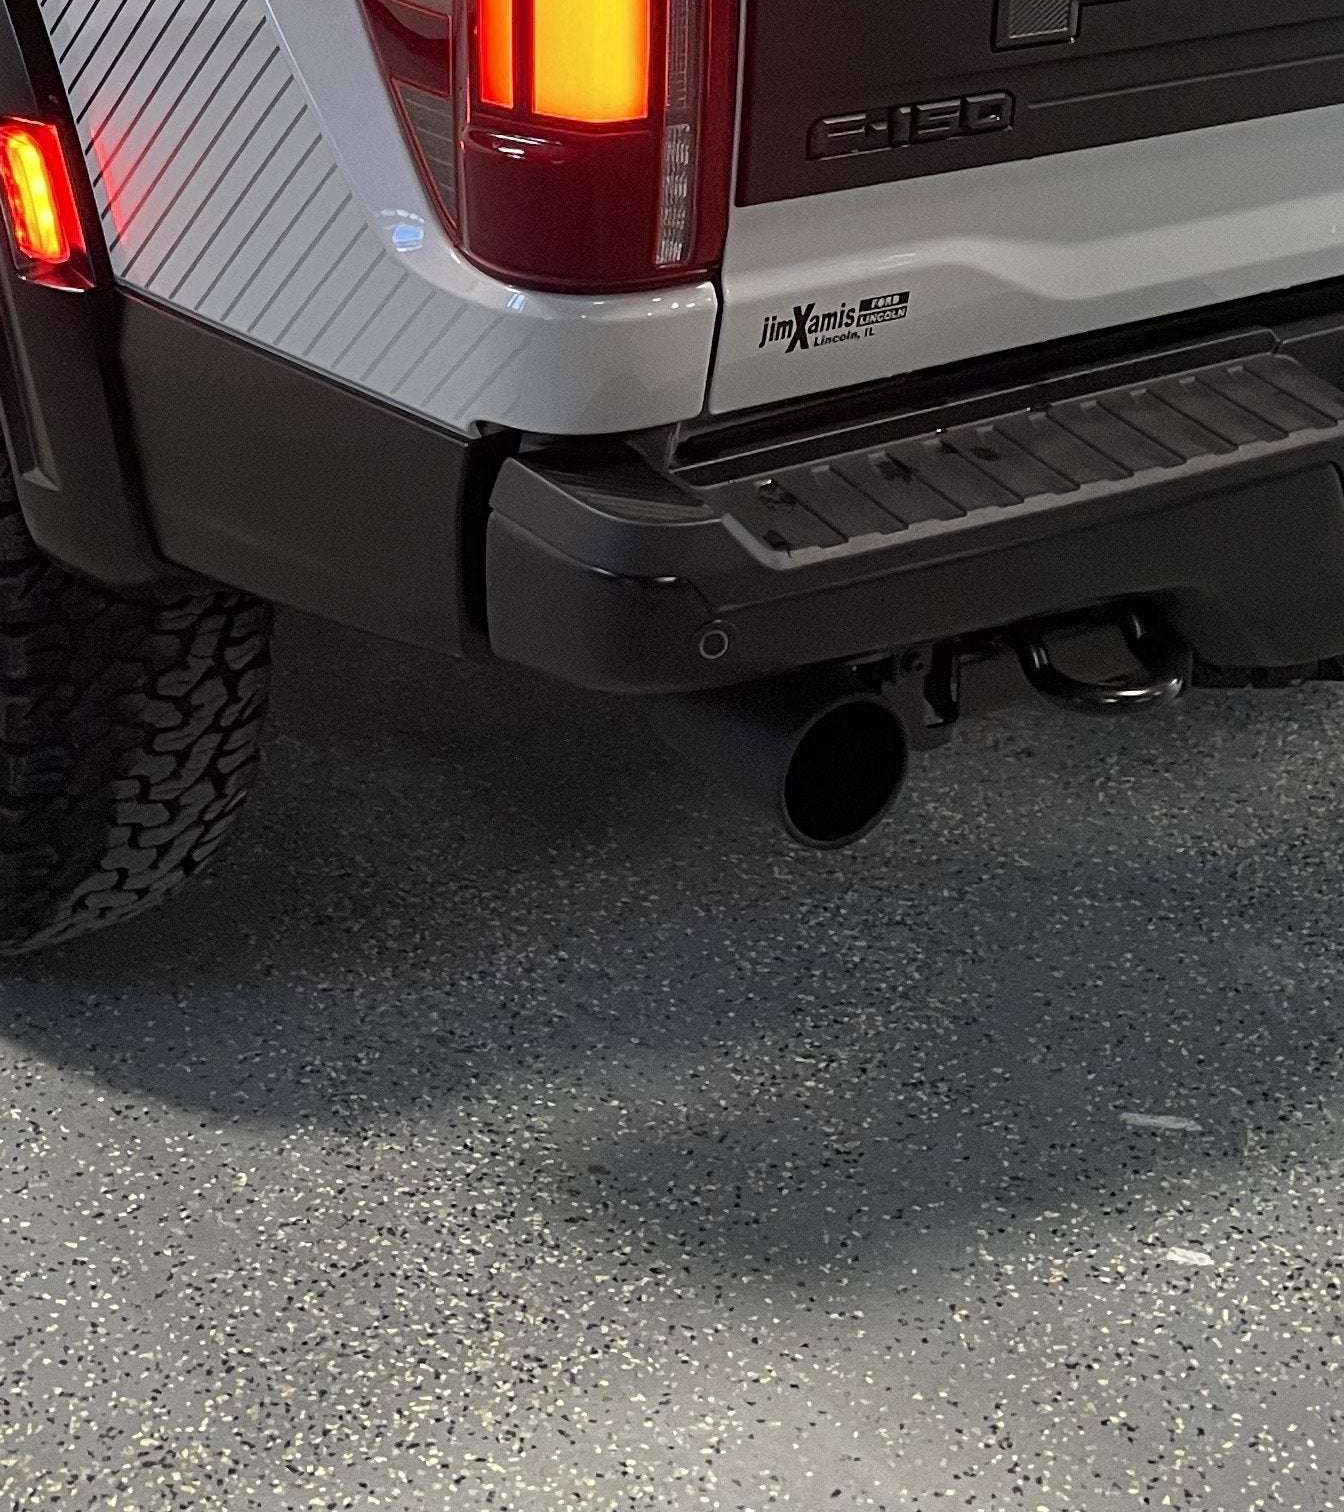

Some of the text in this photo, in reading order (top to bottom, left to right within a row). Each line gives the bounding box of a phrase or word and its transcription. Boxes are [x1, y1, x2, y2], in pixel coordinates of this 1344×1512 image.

[806, 88, 1017, 161] F-150
[870, 295, 901, 309] FORD
[859, 308, 906, 325] LINCOLN
[813, 326, 875, 348] Lincoln, IL
